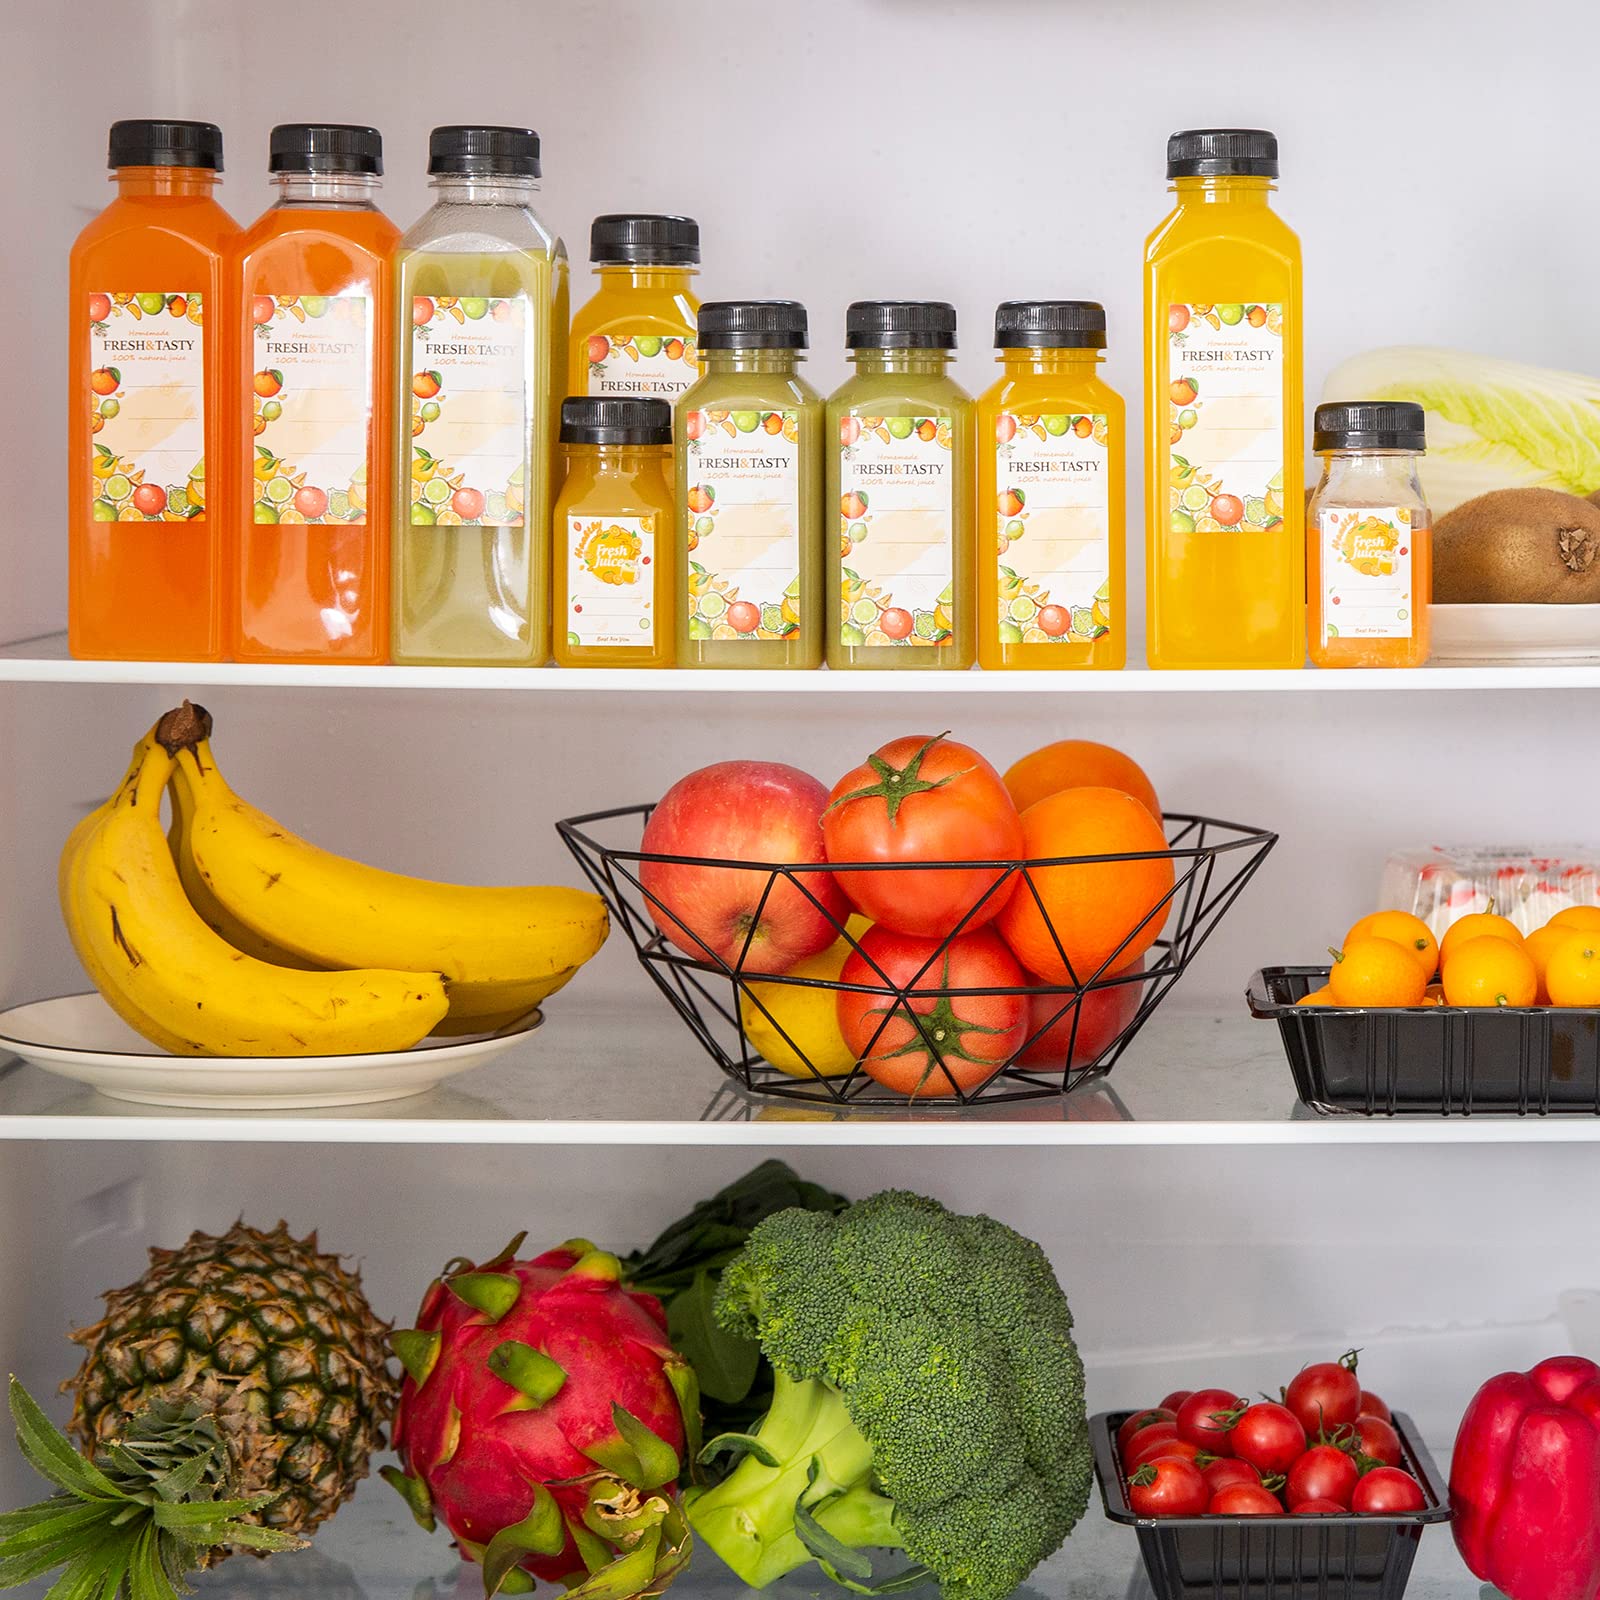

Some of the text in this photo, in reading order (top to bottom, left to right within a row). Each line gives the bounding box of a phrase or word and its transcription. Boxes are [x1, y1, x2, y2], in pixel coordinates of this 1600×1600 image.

[128, 329, 169, 337] Homemade
[103, 340, 195, 351] FRESH&TASTY
[301, 356, 330, 364] natu
[1181, 350, 1274, 361] FRESH&TASTY
[600, 380, 690, 392] FRESH&TASTY
[698, 457, 790, 469] FRESH&TASTY
[1008, 461, 1100, 472] FRESH&TASTY
[852, 464, 944, 475] FRESH&TASTY
[1353, 535, 1385, 548] Fresh
[596, 544, 628, 557] Fresh
[1351, 547, 1383, 560] Juice
[594, 556, 625, 569] Juice
